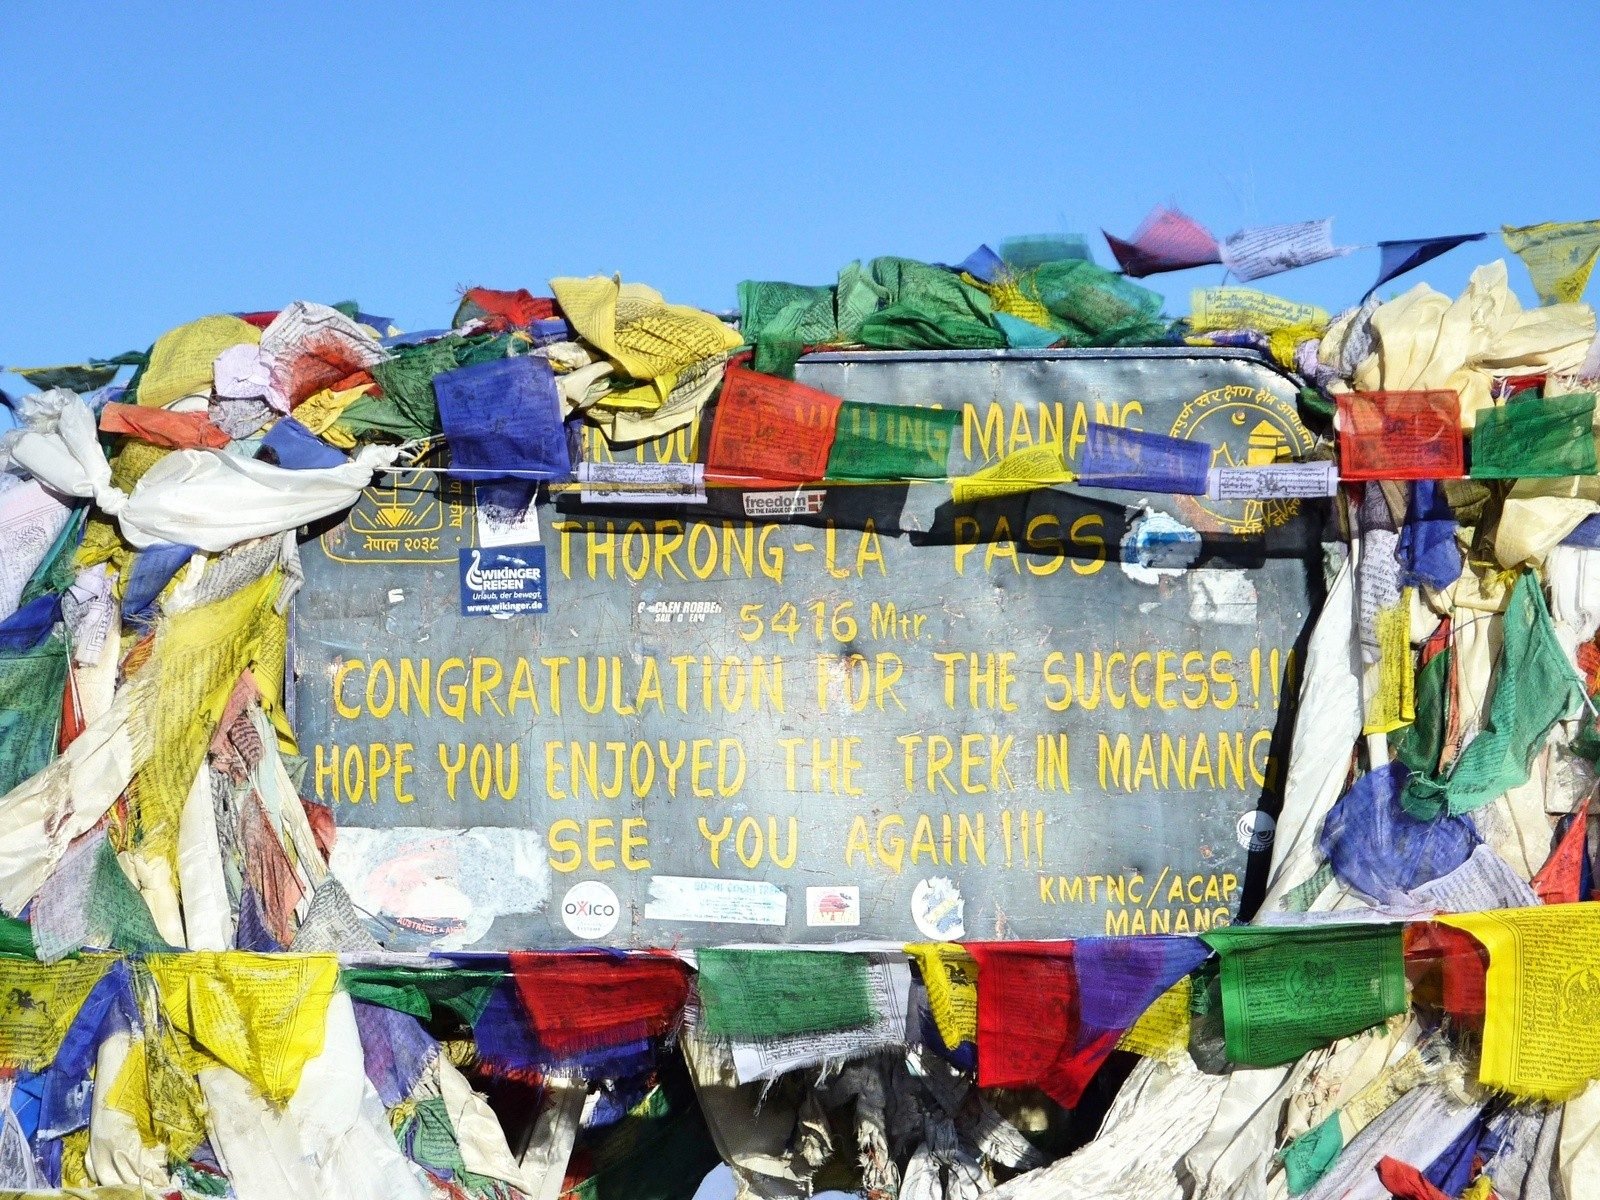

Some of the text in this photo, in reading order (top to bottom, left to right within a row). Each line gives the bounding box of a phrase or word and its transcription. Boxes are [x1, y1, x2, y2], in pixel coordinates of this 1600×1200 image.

[962, 400, 1144, 464] MANANG
[362, 535, 401, 553] नेपाल
[954, 513, 1107, 577] PASS
[481, 567, 540, 580] WIKINGER
[483, 579, 523, 590] REISEN
[467, 601, 543, 613] www.wikinger.de
[473, 591, 498, 601] Urlaub,
[500, 592, 512, 600] der
[332, 655, 786, 723] CONGRATULATION
[817, 652, 907, 712] FOR
[932, 650, 1018, 713] THE
[315, 729, 1277, 804] HOPE YOU ENJOYED THE TREK IN MANANG
[548, 817, 652, 873] SEE
[697, 817, 797, 870] YOU
[1106, 907, 1231, 936] MANANG
